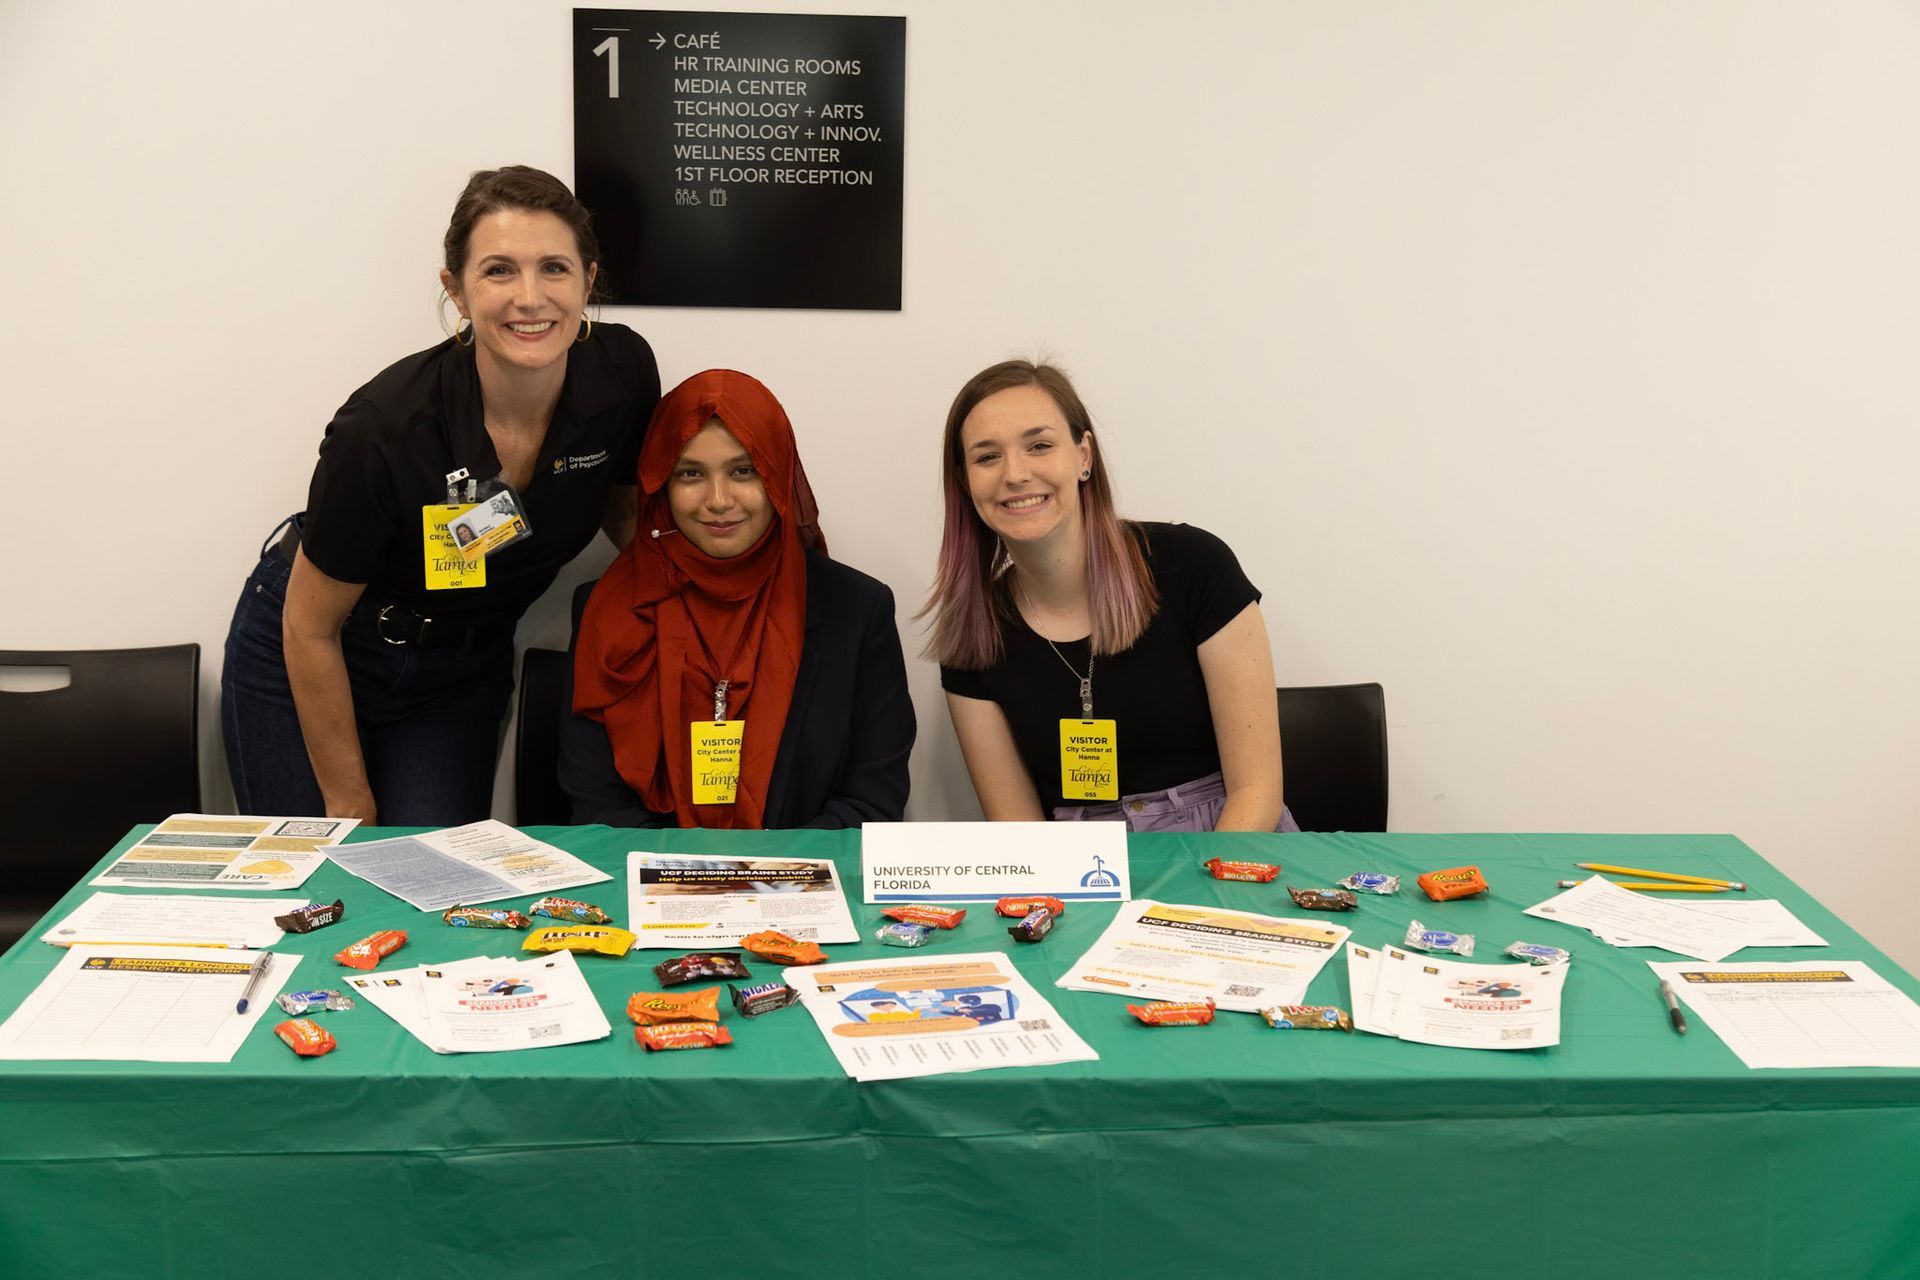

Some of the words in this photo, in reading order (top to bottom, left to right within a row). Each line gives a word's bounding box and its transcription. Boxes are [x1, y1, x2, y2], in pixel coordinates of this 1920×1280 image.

[674, 32, 721, 50] CAFÉ
[592, 36, 619, 99] 1
[674, 56, 699, 72] HR
[702, 57, 789, 74] TRAINING
[794, 59, 861, 75] ROOMS
[674, 78, 732, 94] MEDIA
[737, 80, 807, 96] CENTER
[674, 100, 799, 118] TECHNOLOGY
[804, 106, 816, 118] +
[820, 104, 864, 119] ARTS
[674, 122, 799, 140] TECHNOLOGY
[804, 128, 816, 140] +
[821, 126, 882, 142] INNOV.
[674, 144, 766, 161] WELLNESS
[770, 146, 840, 163] CENTER
[675, 166, 705, 182] 1ST
[710, 168, 769, 183] FLOOR
[774, 169, 873, 186] RECEPTION
[701, 738, 741, 747] VISITOR
[1070, 736, 1108, 744] VISITOR
[1068, 769, 1111, 787] Tampa
[873, 866, 951, 877] UNIVERSITY
[954, 866, 972, 876] OF
[975, 865, 1035, 876] CENTRAL
[874, 879, 931, 890] FLORIDA
[319, 911, 333, 924] SIZE
[1141, 917, 1168, 925] UCF
[1170, 922, 1233, 934] DECIDING
[1234, 930, 1282, 941] BRAINS
[1283, 938, 1330, 948] STUDY
[109, 964, 179, 972] RESEARCH
[181, 966, 242, 974] NETWORK
[111, 958, 177, 967] LEARNING
[470, 1002, 539, 1011] NEEDED
